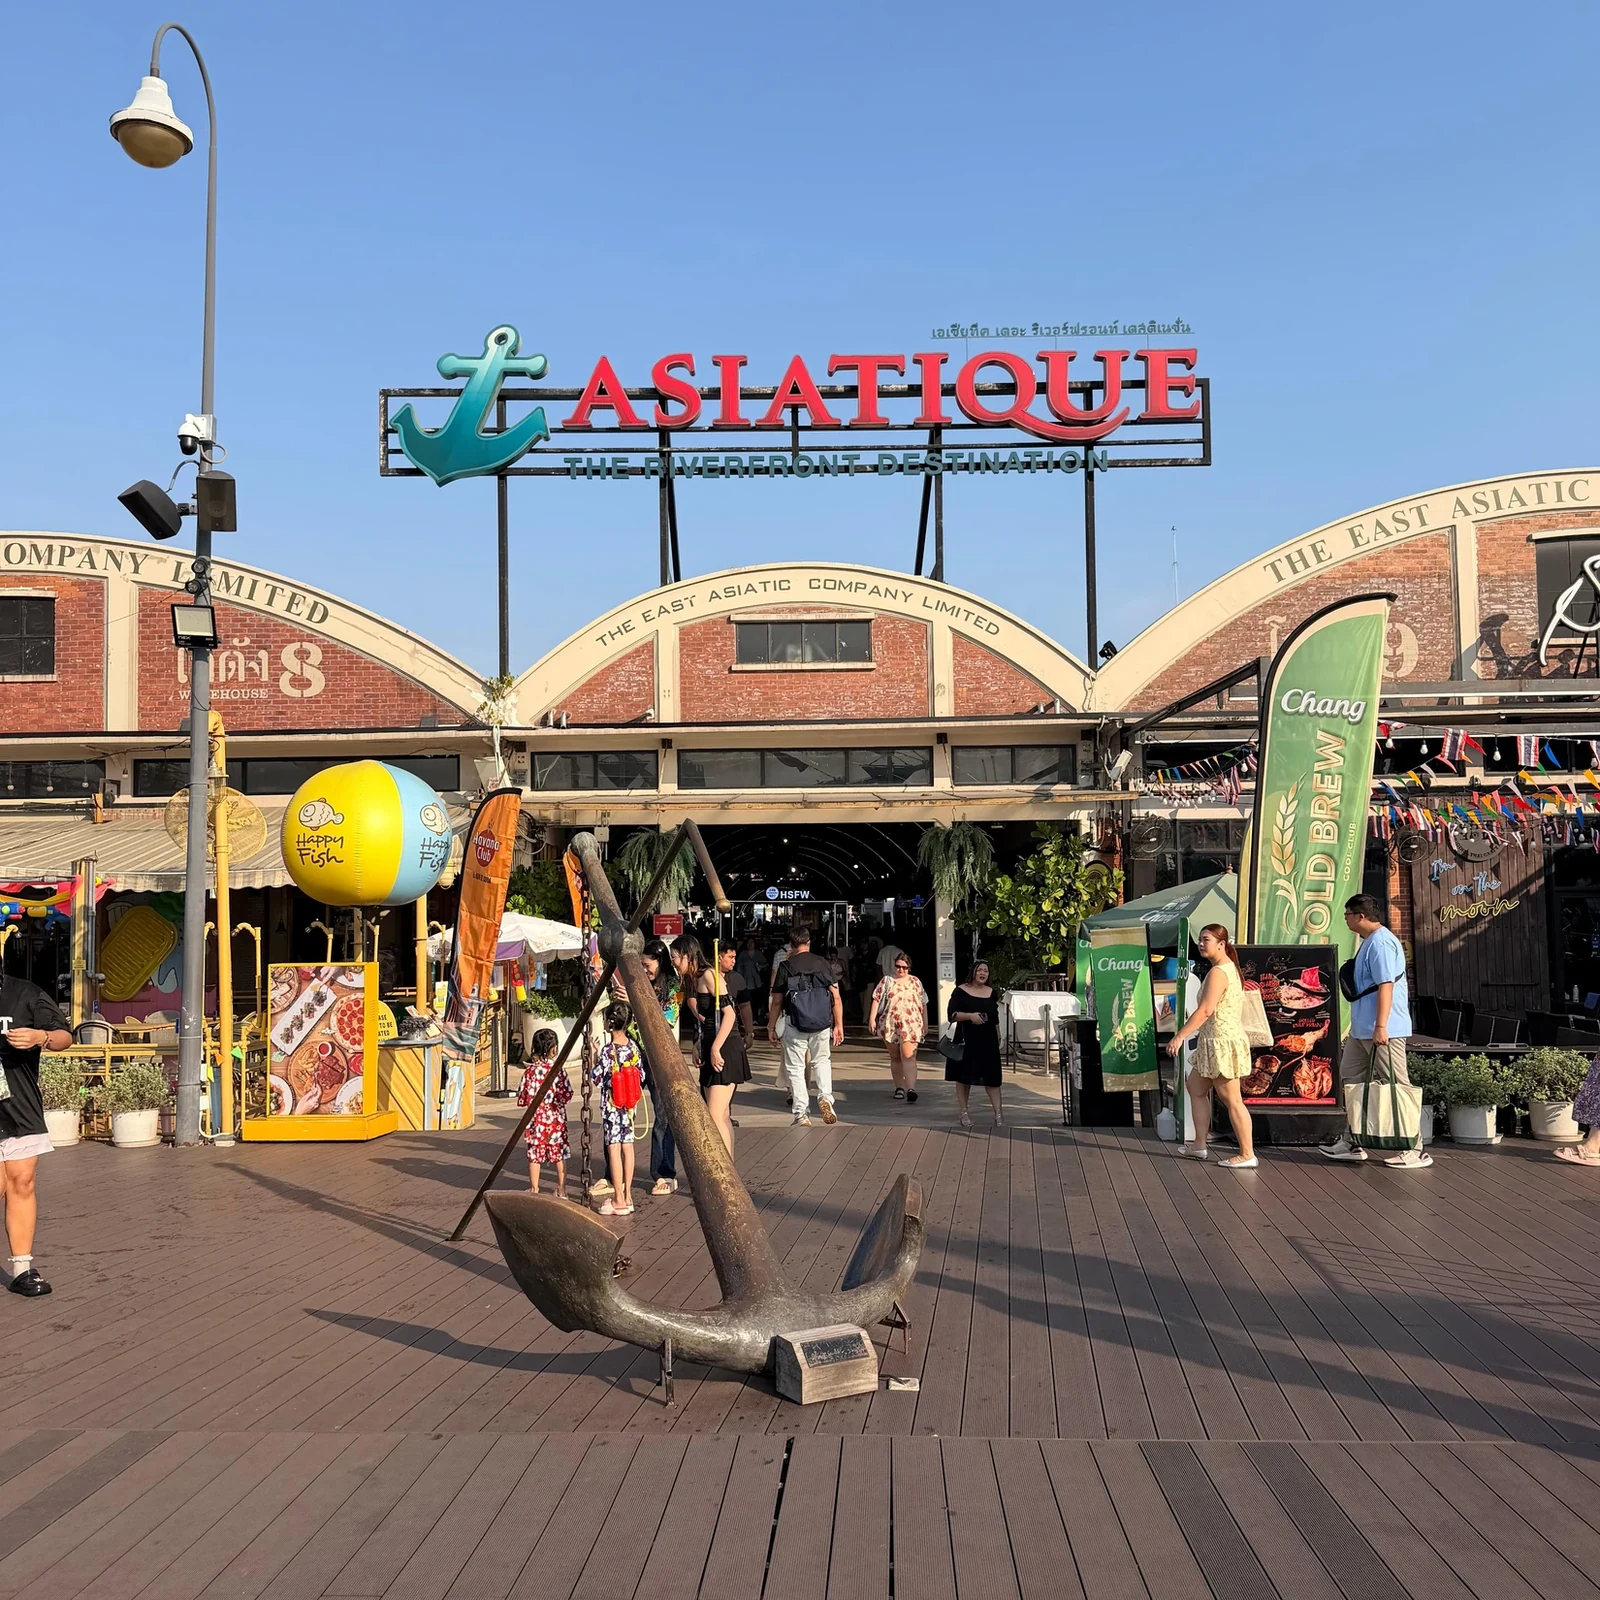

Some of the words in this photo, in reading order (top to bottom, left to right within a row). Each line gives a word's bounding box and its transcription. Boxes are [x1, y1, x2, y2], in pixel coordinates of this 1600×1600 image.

[996, 326, 1027, 337] เดอะ
[561, 348, 1202, 443] ASIATIQUE
[563, 457, 629, 480] THE
[644, 454, 861, 479] RIVERFRONT
[877, 449, 1109, 476] DESTINATION
[1263, 538, 1333, 584] THE
[1346, 503, 1429, 549] EAST
[1451, 478, 1591, 520] ASIATIC
[3, 542, 149, 575] OMPANY
[171, 560, 330, 625] LMITED
[596, 618, 636, 648] THE
[641, 595, 697, 623] EAST
[708, 578, 792, 602] ASIATIC
[808, 578, 914, 603] COMPANY
[922, 596, 1001, 636] LIMITED
[279, 641, 326, 698] 8
[178, 688, 269, 700] WEHOUSE
[1280, 687, 1366, 724] Chang
[1309, 729, 1347, 845] BREW
[296, 833, 344, 849] Happy
[473, 832, 500, 851] Havana
[477, 847, 491, 862] Club
[296, 848, 344, 868] Fish
[780, 890, 810, 899] HSFW
[1299, 853, 1336, 943] OLD
[1440, 898, 1520, 923] moon
[1097, 957, 1145, 972] Chang
